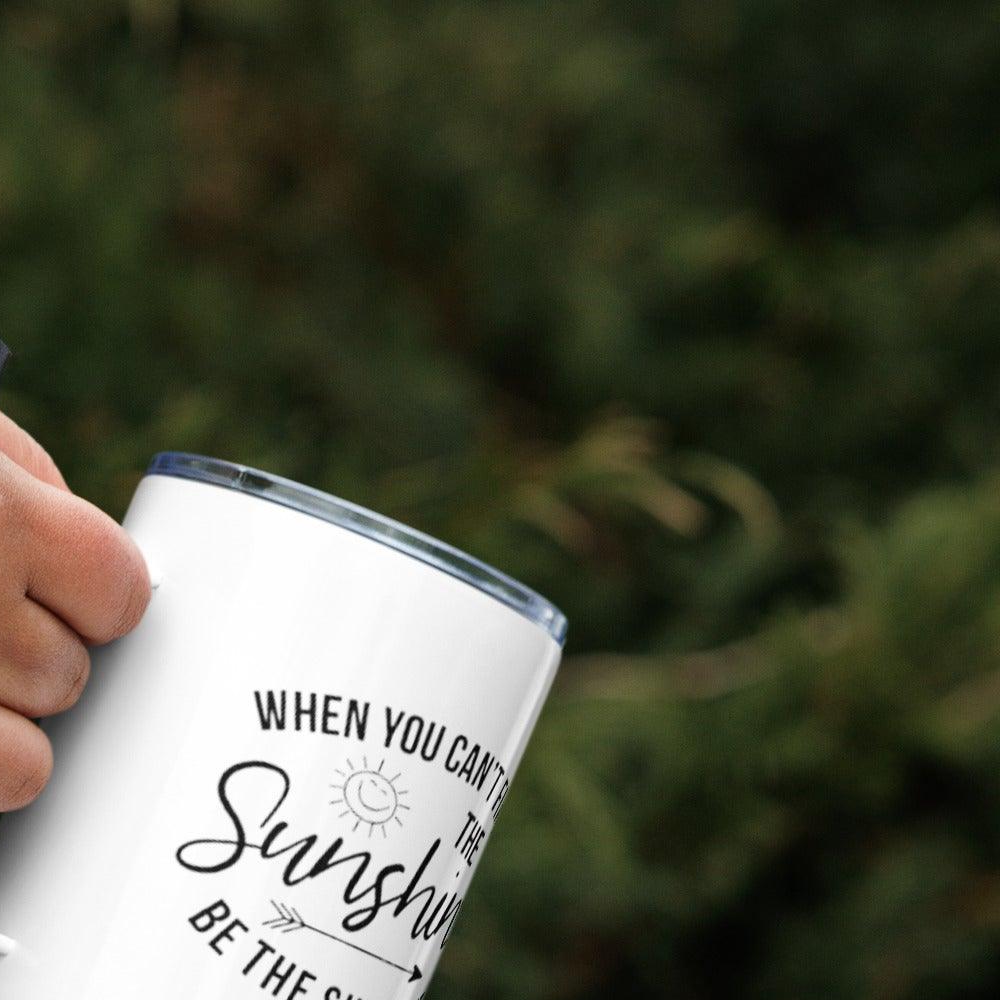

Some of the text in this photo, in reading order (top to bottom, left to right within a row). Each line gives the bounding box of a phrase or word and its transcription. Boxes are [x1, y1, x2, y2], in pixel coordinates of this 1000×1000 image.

[254, 690, 370, 741] WHEN
[384, 706, 446, 762] YOU
[444, 734, 505, 802] CAN'T
[175, 760, 462, 950] Sunshin
[454, 811, 486, 867] THE
[187, 899, 249, 956] BE
